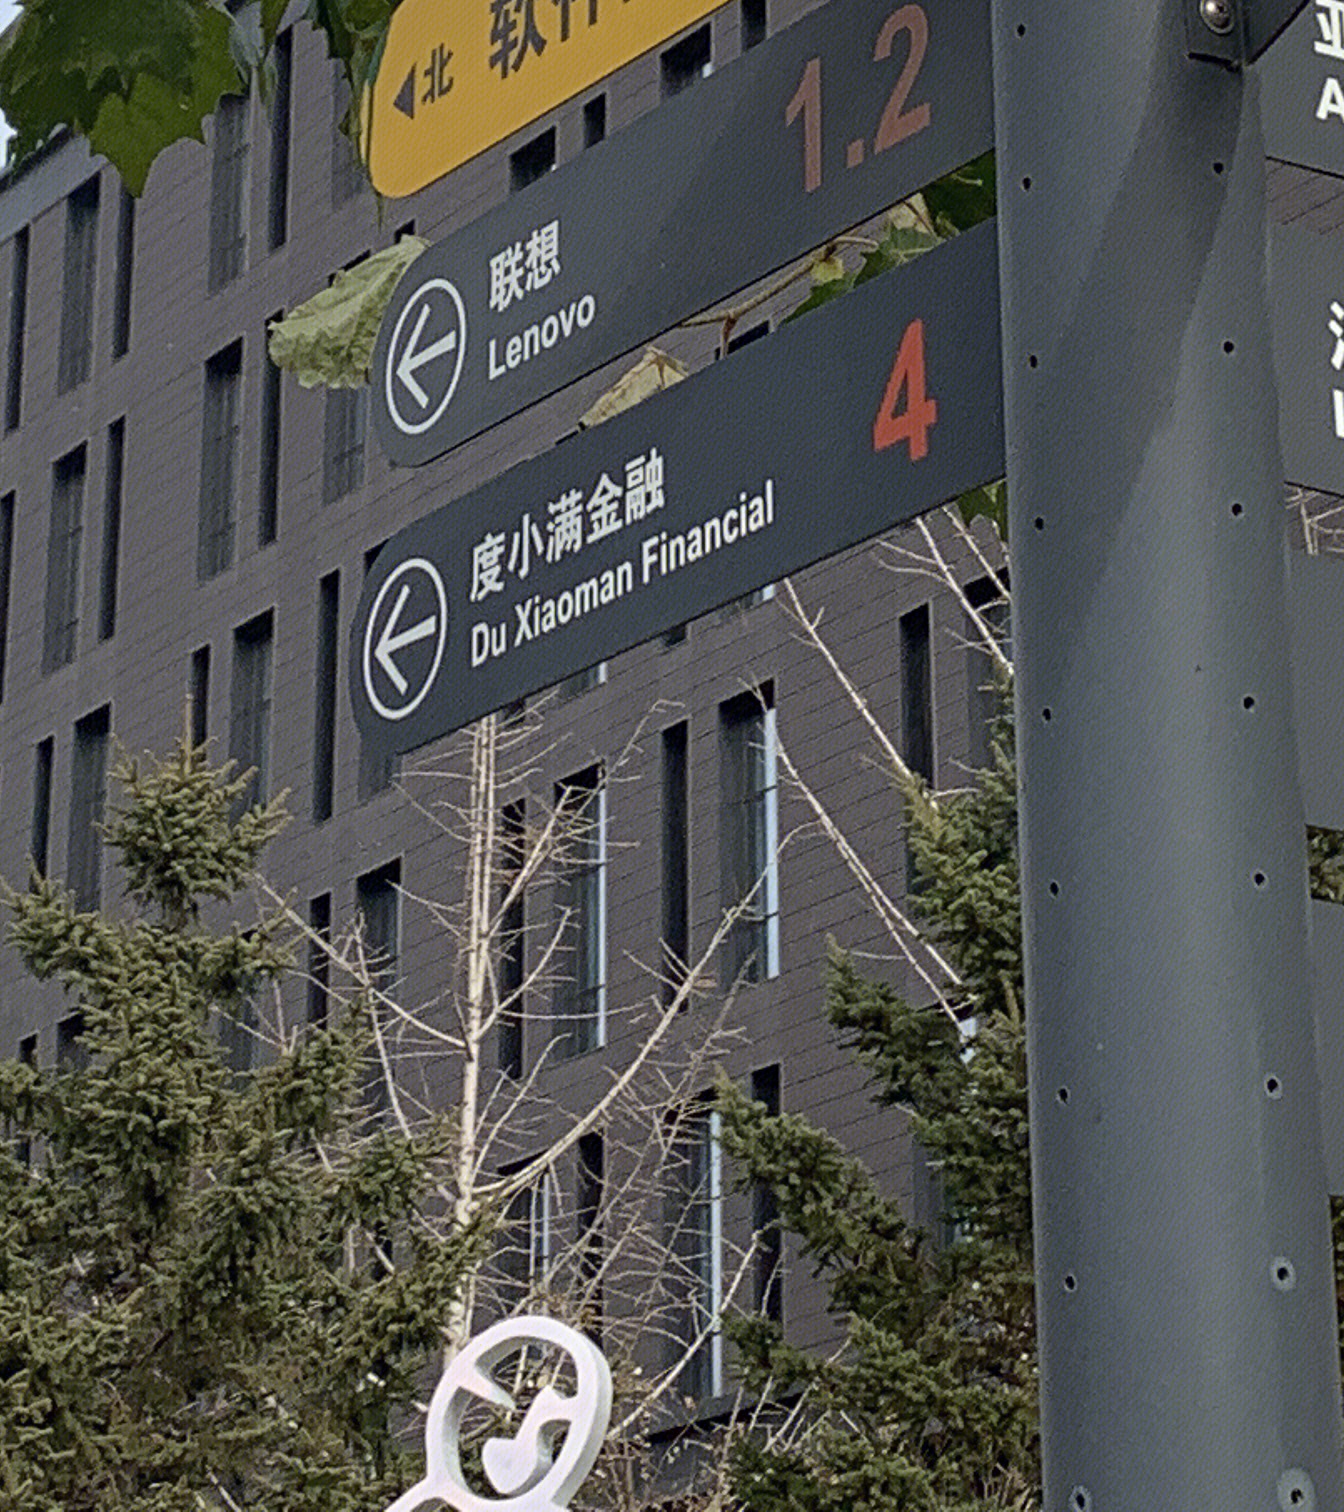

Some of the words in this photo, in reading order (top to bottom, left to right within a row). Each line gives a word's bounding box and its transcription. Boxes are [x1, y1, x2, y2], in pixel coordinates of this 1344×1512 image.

[421, 43, 454, 107] 北
[784, 3, 932, 194] 1.2
[487, 294, 596, 381] Lenovo
[488, 220, 561, 313] 联想
[872, 318, 938, 462] 4
[469, 447, 666, 604] 度小满金融
[470, 611, 507, 668] Du
[513, 562, 634, 649] Xiaoman
[641, 480, 776, 585] Financial
